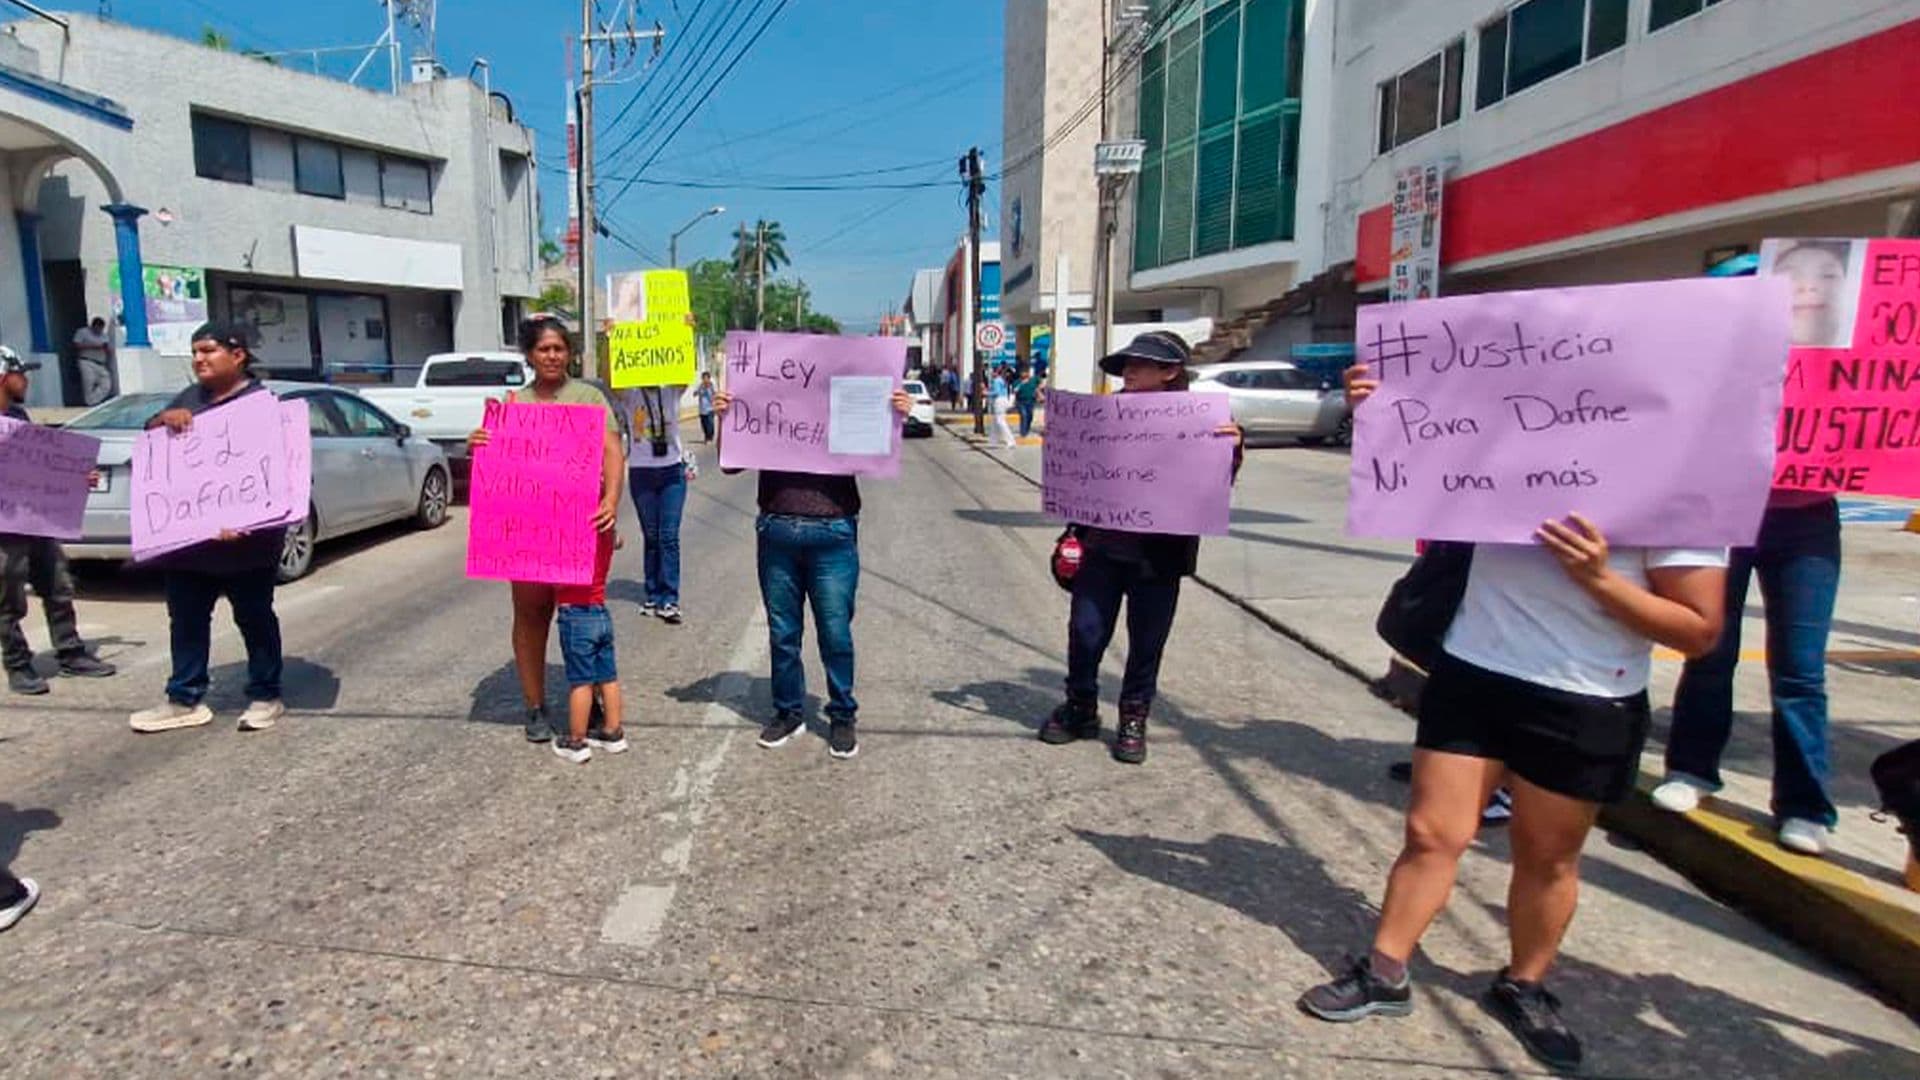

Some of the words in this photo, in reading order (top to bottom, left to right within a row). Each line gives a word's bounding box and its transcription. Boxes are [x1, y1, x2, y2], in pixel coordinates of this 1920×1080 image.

[1872, 302, 1920, 346] SO
[731, 341, 816, 388] #Ley
[1367, 321, 1613, 380] #Justicia
[1392, 399, 1479, 445] Para
[1502, 389, 1630, 431] Dafne
[1776, 407, 1920, 454] JUSTICI
[145, 454, 272, 535] Dafne!
[1372, 457, 1409, 492] Ni
[1442, 472, 1497, 493] una
[1526, 460, 1600, 488] más
[1776, 463, 1870, 491] AFNE
